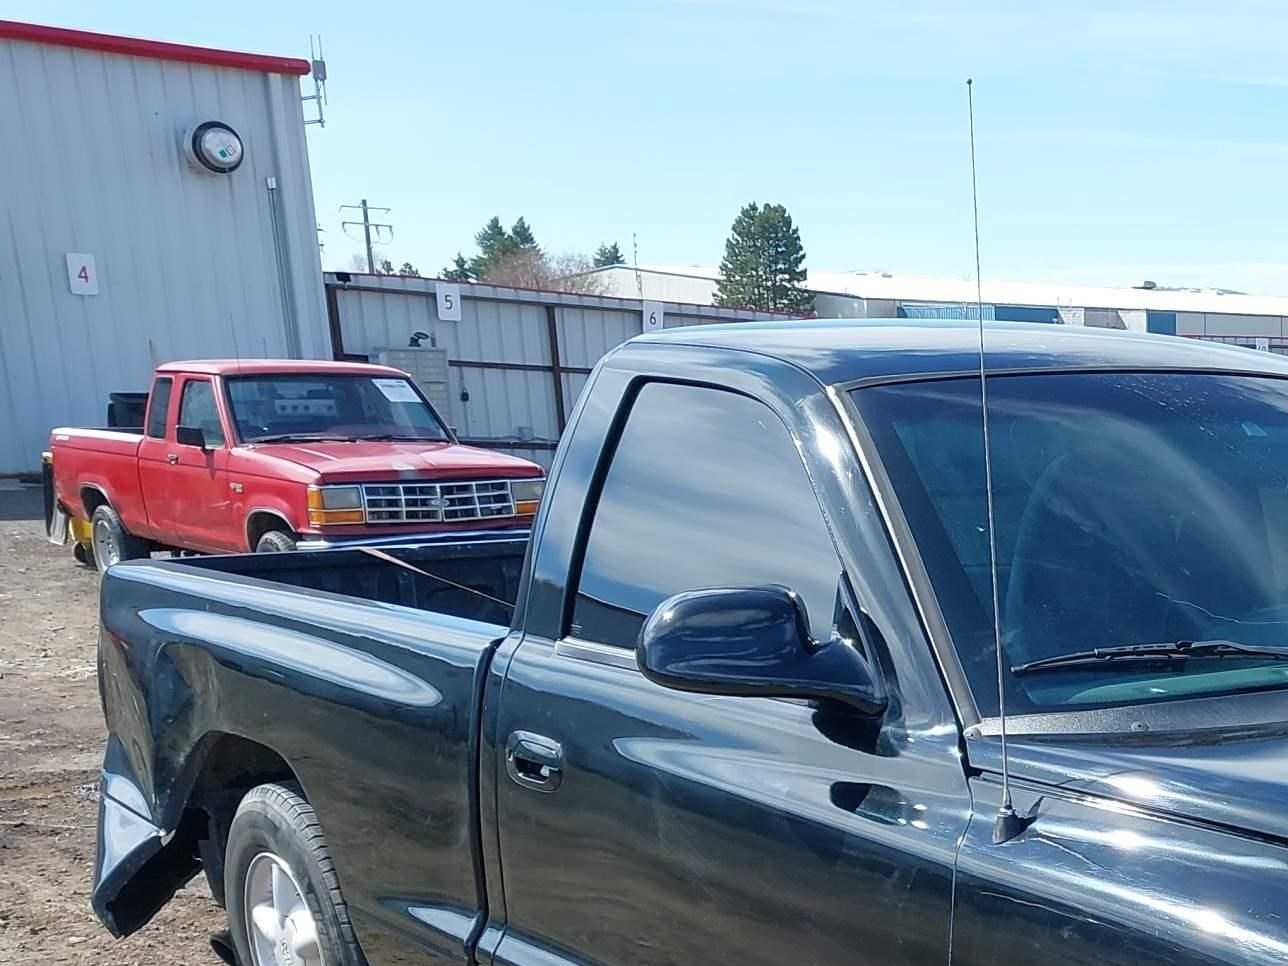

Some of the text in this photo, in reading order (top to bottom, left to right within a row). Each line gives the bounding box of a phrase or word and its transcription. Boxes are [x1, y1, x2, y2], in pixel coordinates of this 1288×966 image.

[77, 265, 89, 284] 4
[444, 294, 454, 311] 5
[649, 311, 657, 326] 6
